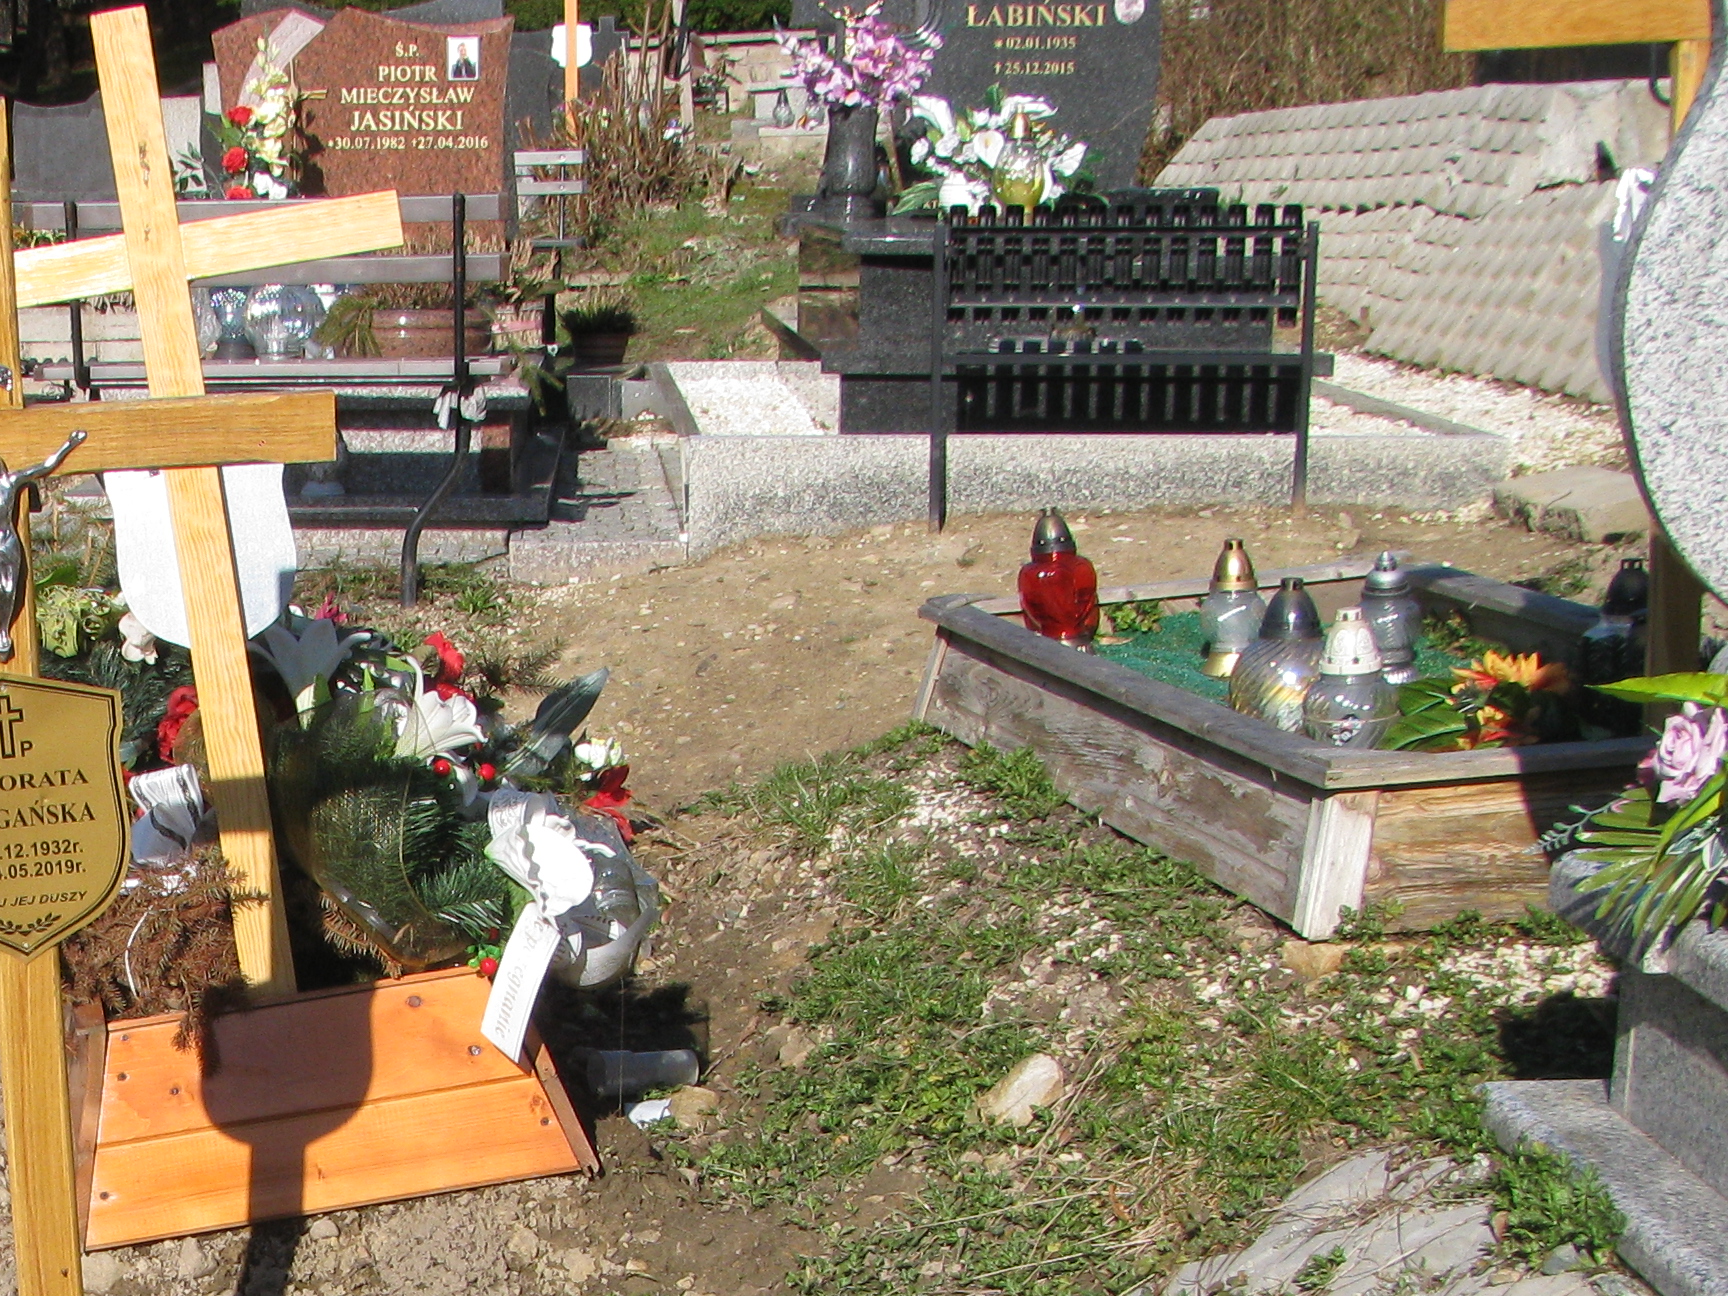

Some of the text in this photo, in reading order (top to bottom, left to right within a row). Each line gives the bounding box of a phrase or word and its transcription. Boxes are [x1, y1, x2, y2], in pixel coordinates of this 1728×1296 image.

[395, 41, 419, 57] Ś.P.
[1006, 36, 1076, 49] 02.01.1935
[378, 66, 437, 82] PIOTR
[1005, 61, 1074, 75] 25.12.2015
[340, 87, 475, 104] MIECZYSŁAW
[350, 106, 464, 131] JASIŃSKI
[20, 741, 33, 757] P
[10, 895, 36, 908] JEJ
[39, 890, 88, 905] DUSZY
